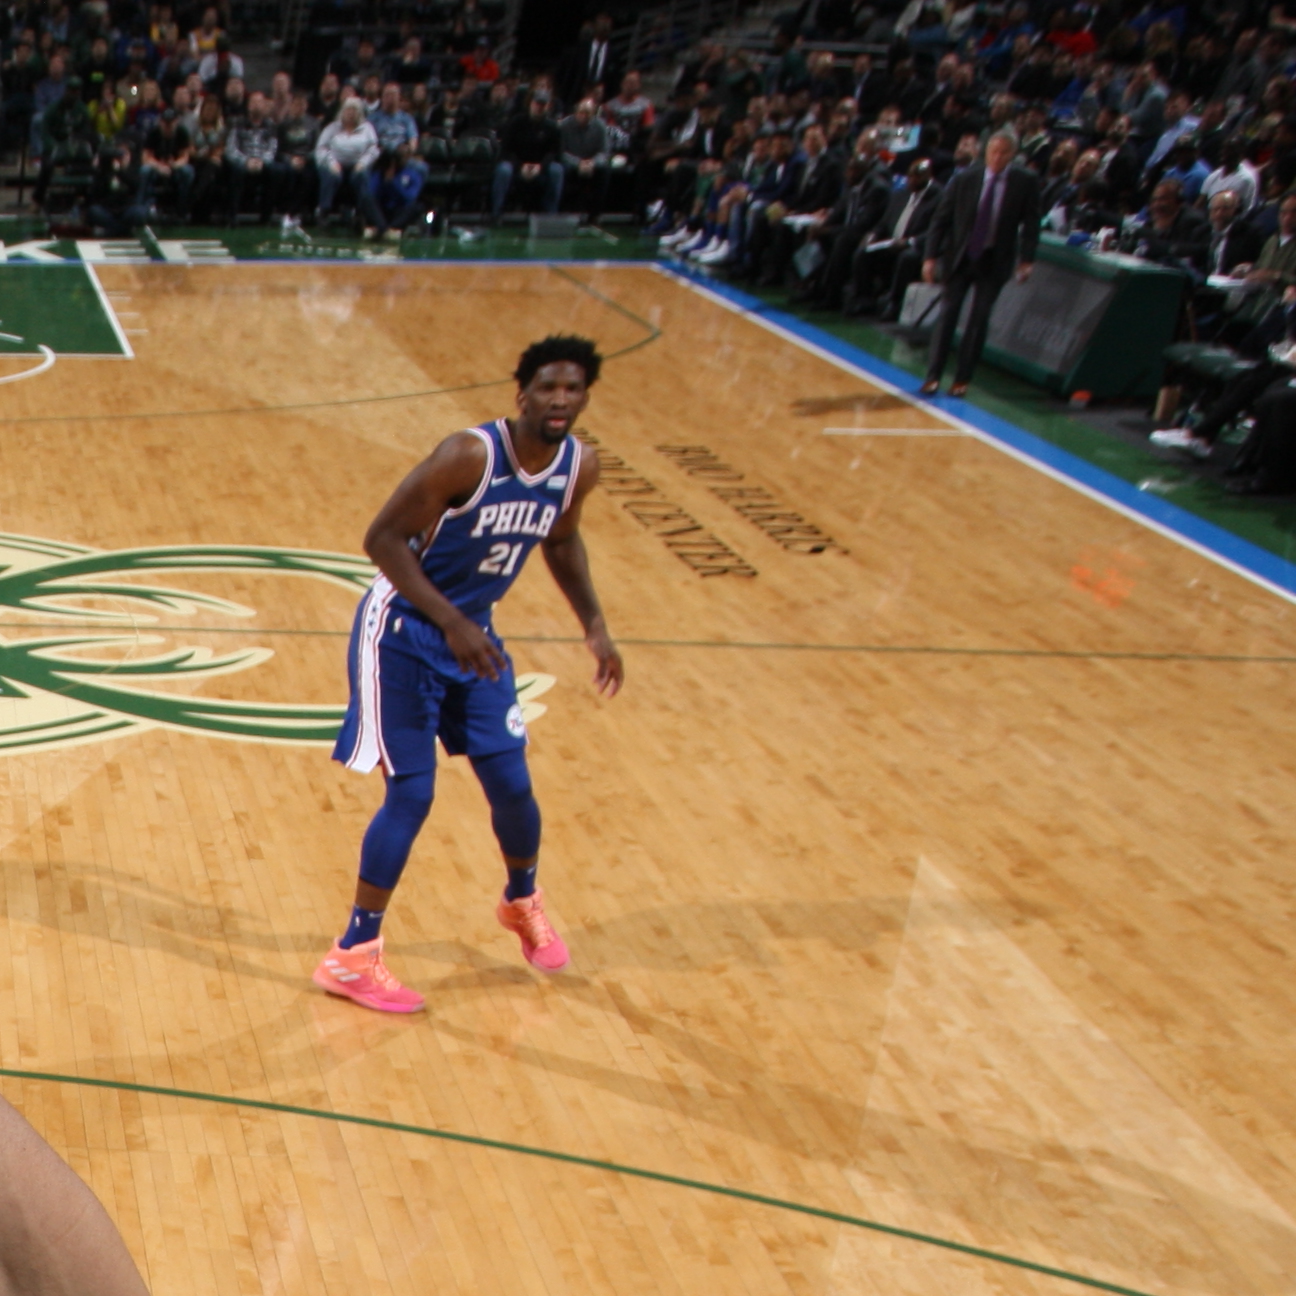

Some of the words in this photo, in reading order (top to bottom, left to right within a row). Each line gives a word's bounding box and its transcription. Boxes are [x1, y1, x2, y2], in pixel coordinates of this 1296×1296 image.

[470, 500, 558, 539] PHILA
[621, 499, 760, 578] CENTER
[477, 540, 524, 578] 21
